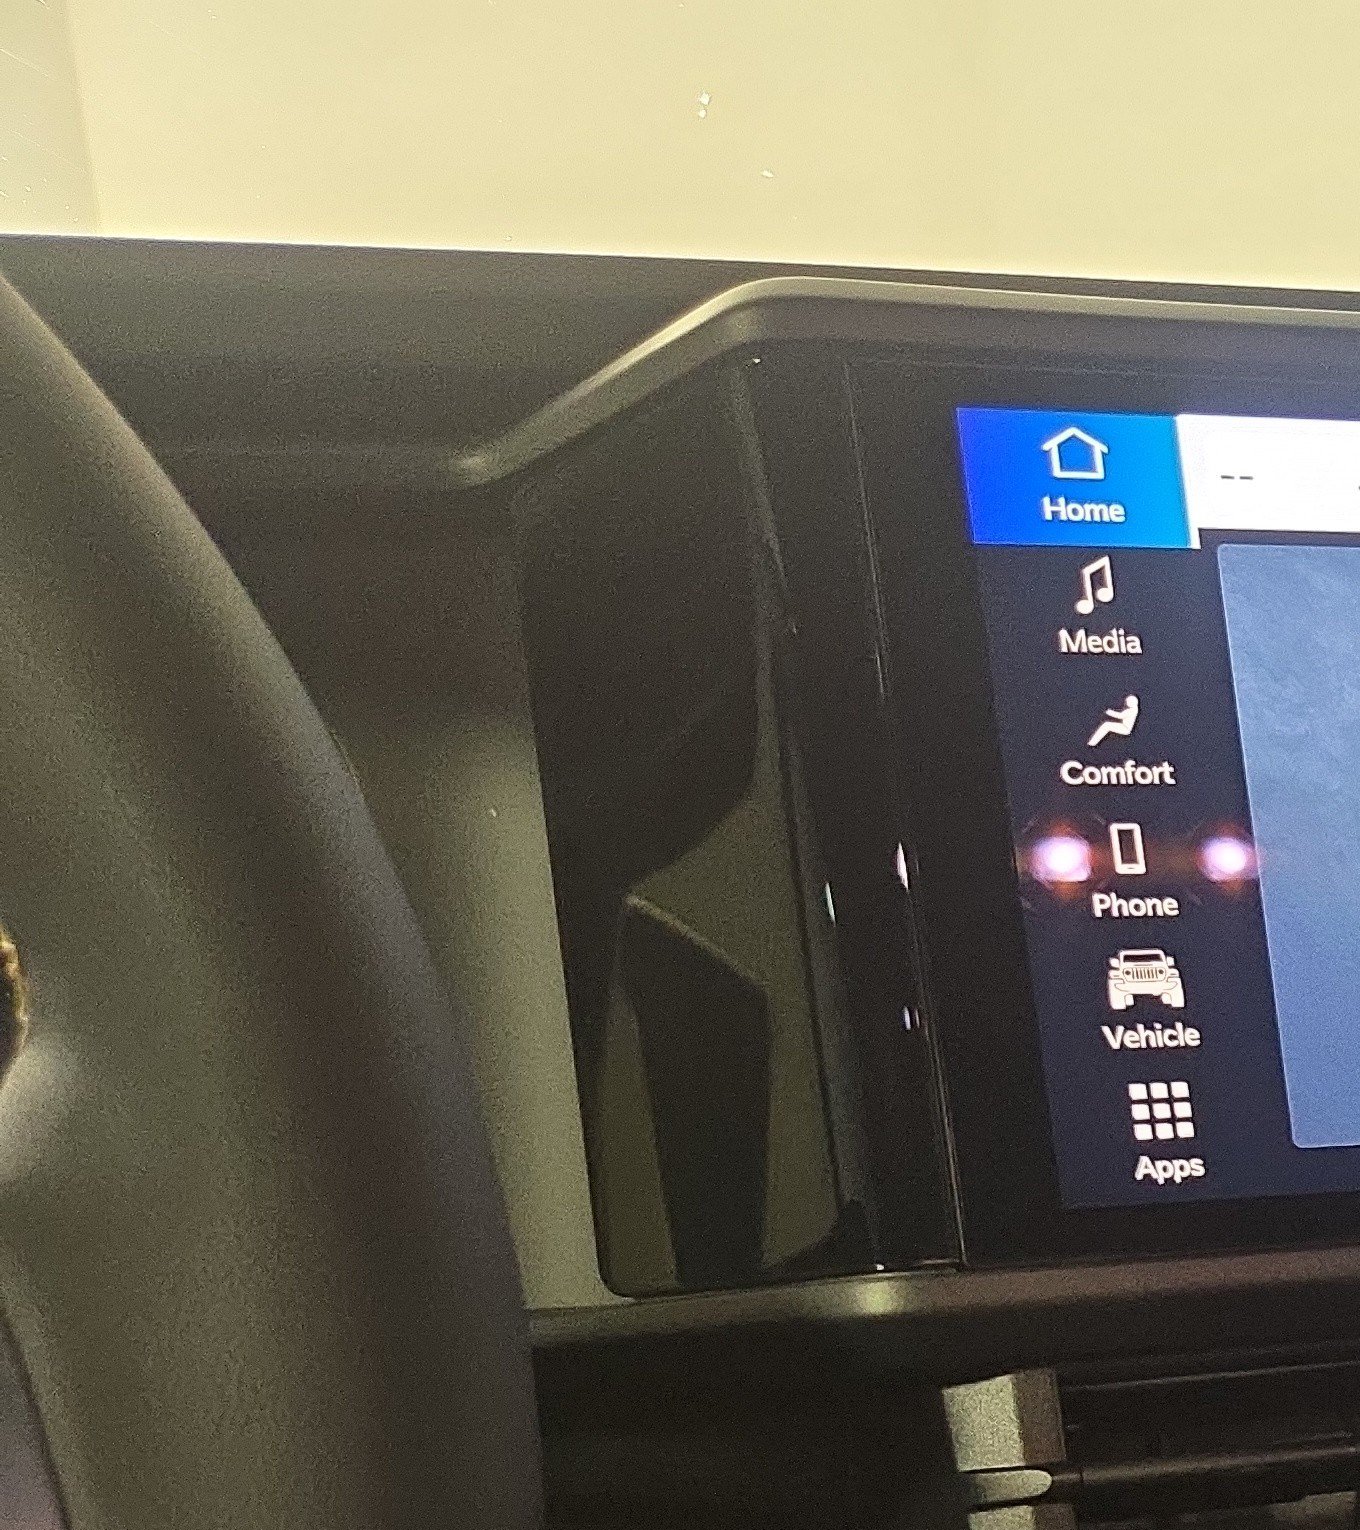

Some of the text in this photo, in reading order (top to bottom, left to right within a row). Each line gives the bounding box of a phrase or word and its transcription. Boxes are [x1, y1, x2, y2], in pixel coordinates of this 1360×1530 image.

[1041, 495, 1126, 523] Home
[1058, 628, 1143, 654] Media
[1060, 760, 1176, 786] Comfort
[1092, 892, 1180, 918] Phone
[1101, 1021, 1201, 1049] Vehicle
[1134, 1155, 1206, 1185] Apps
